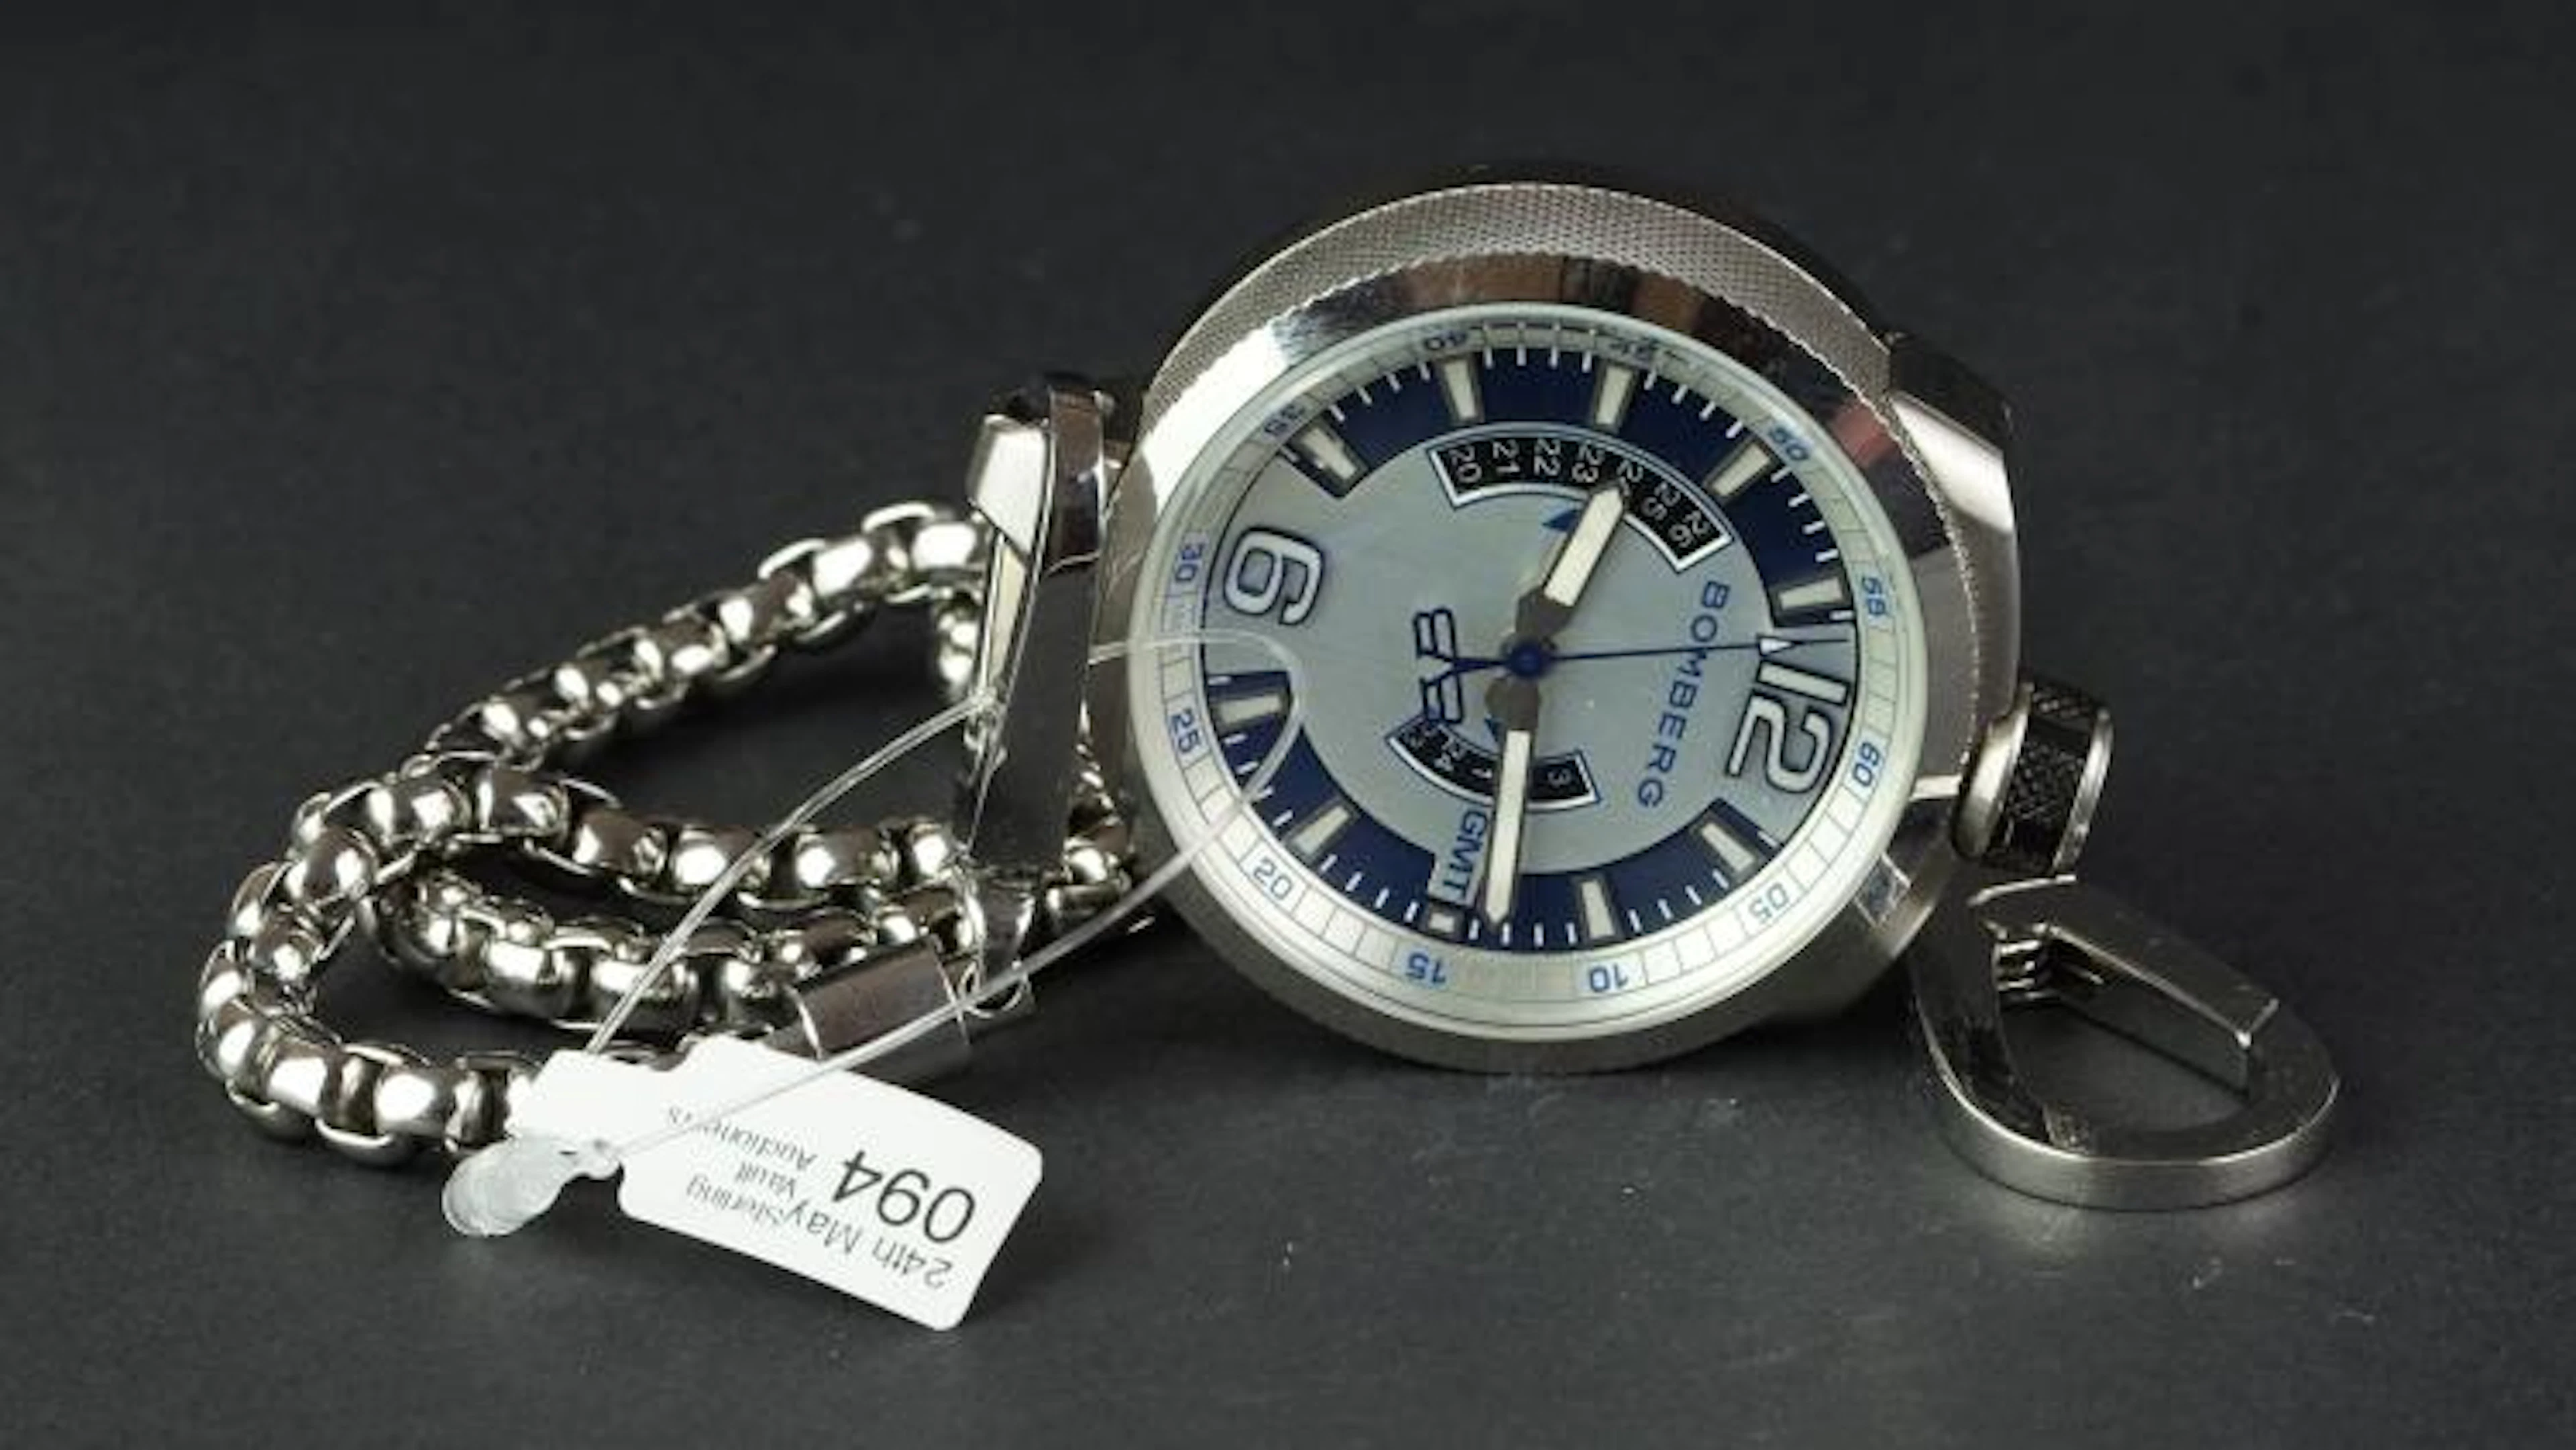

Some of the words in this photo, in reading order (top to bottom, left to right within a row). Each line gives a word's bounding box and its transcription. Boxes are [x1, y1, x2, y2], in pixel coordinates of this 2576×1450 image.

[1447, 444, 1483, 484] 20
[1491, 439, 1521, 475] 21
[1534, 438, 1563, 476] 22
[1572, 438, 1607, 484] 23
[1767, 425, 1810, 463] 50
[1173, 540, 1206, 584] 30
[1223, 526, 1325, 626] 6
[1637, 579, 1731, 809] BOMBERG
[1169, 707, 1201, 754] 25
[1724, 658, 1851, 794] 12
[1851, 741, 1880, 788] 60
[1442, 811, 1489, 899] GMT
[1252, 857, 1293, 900] 20
[1749, 882, 1790, 924] 05
[1406, 951, 1448, 984] 15
[1589, 964, 1628, 993] 10
[668, 1105, 818, 1171] Auctionrs
[831, 1149, 977, 1245] 094
[782, 1199, 863, 1256] May
[873, 1236, 953, 1290] 24th
